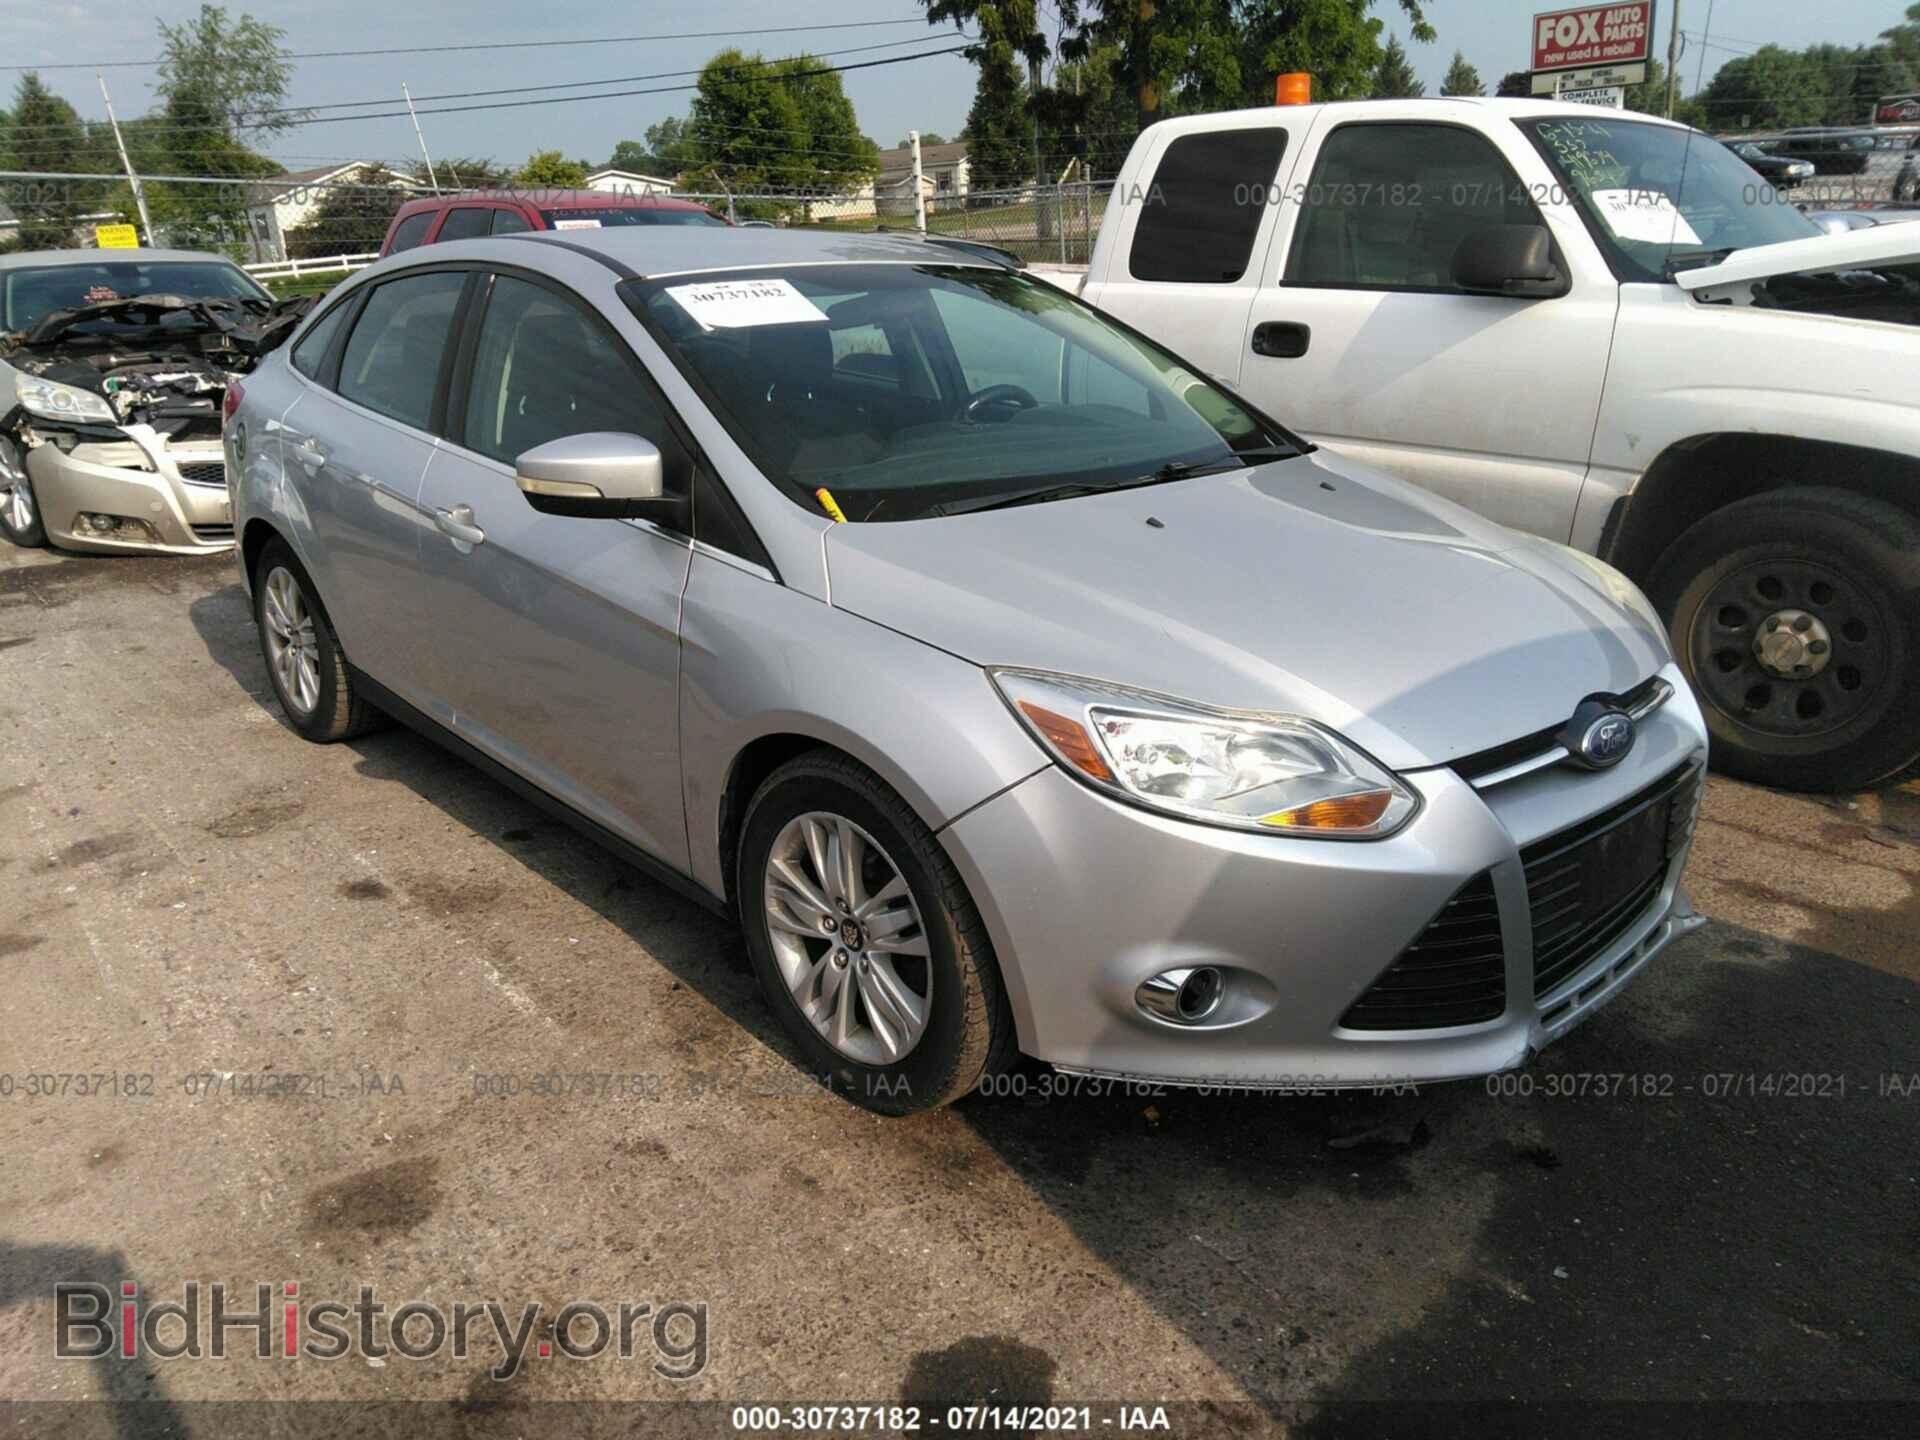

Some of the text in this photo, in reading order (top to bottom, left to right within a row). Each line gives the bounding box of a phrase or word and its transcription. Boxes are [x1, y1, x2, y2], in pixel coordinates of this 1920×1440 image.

[1604, 6, 1642, 26] AUTO
[1538, 11, 1602, 50] FOX
[1603, 22, 1645, 42] PARTS
[1543, 52, 1566, 64] new
[1567, 46, 1591, 61] used
[1603, 42, 1636, 57] rebuilt
[1562, 89, 1609, 100] COMPLETE
[691, 288, 785, 303] 30737182
